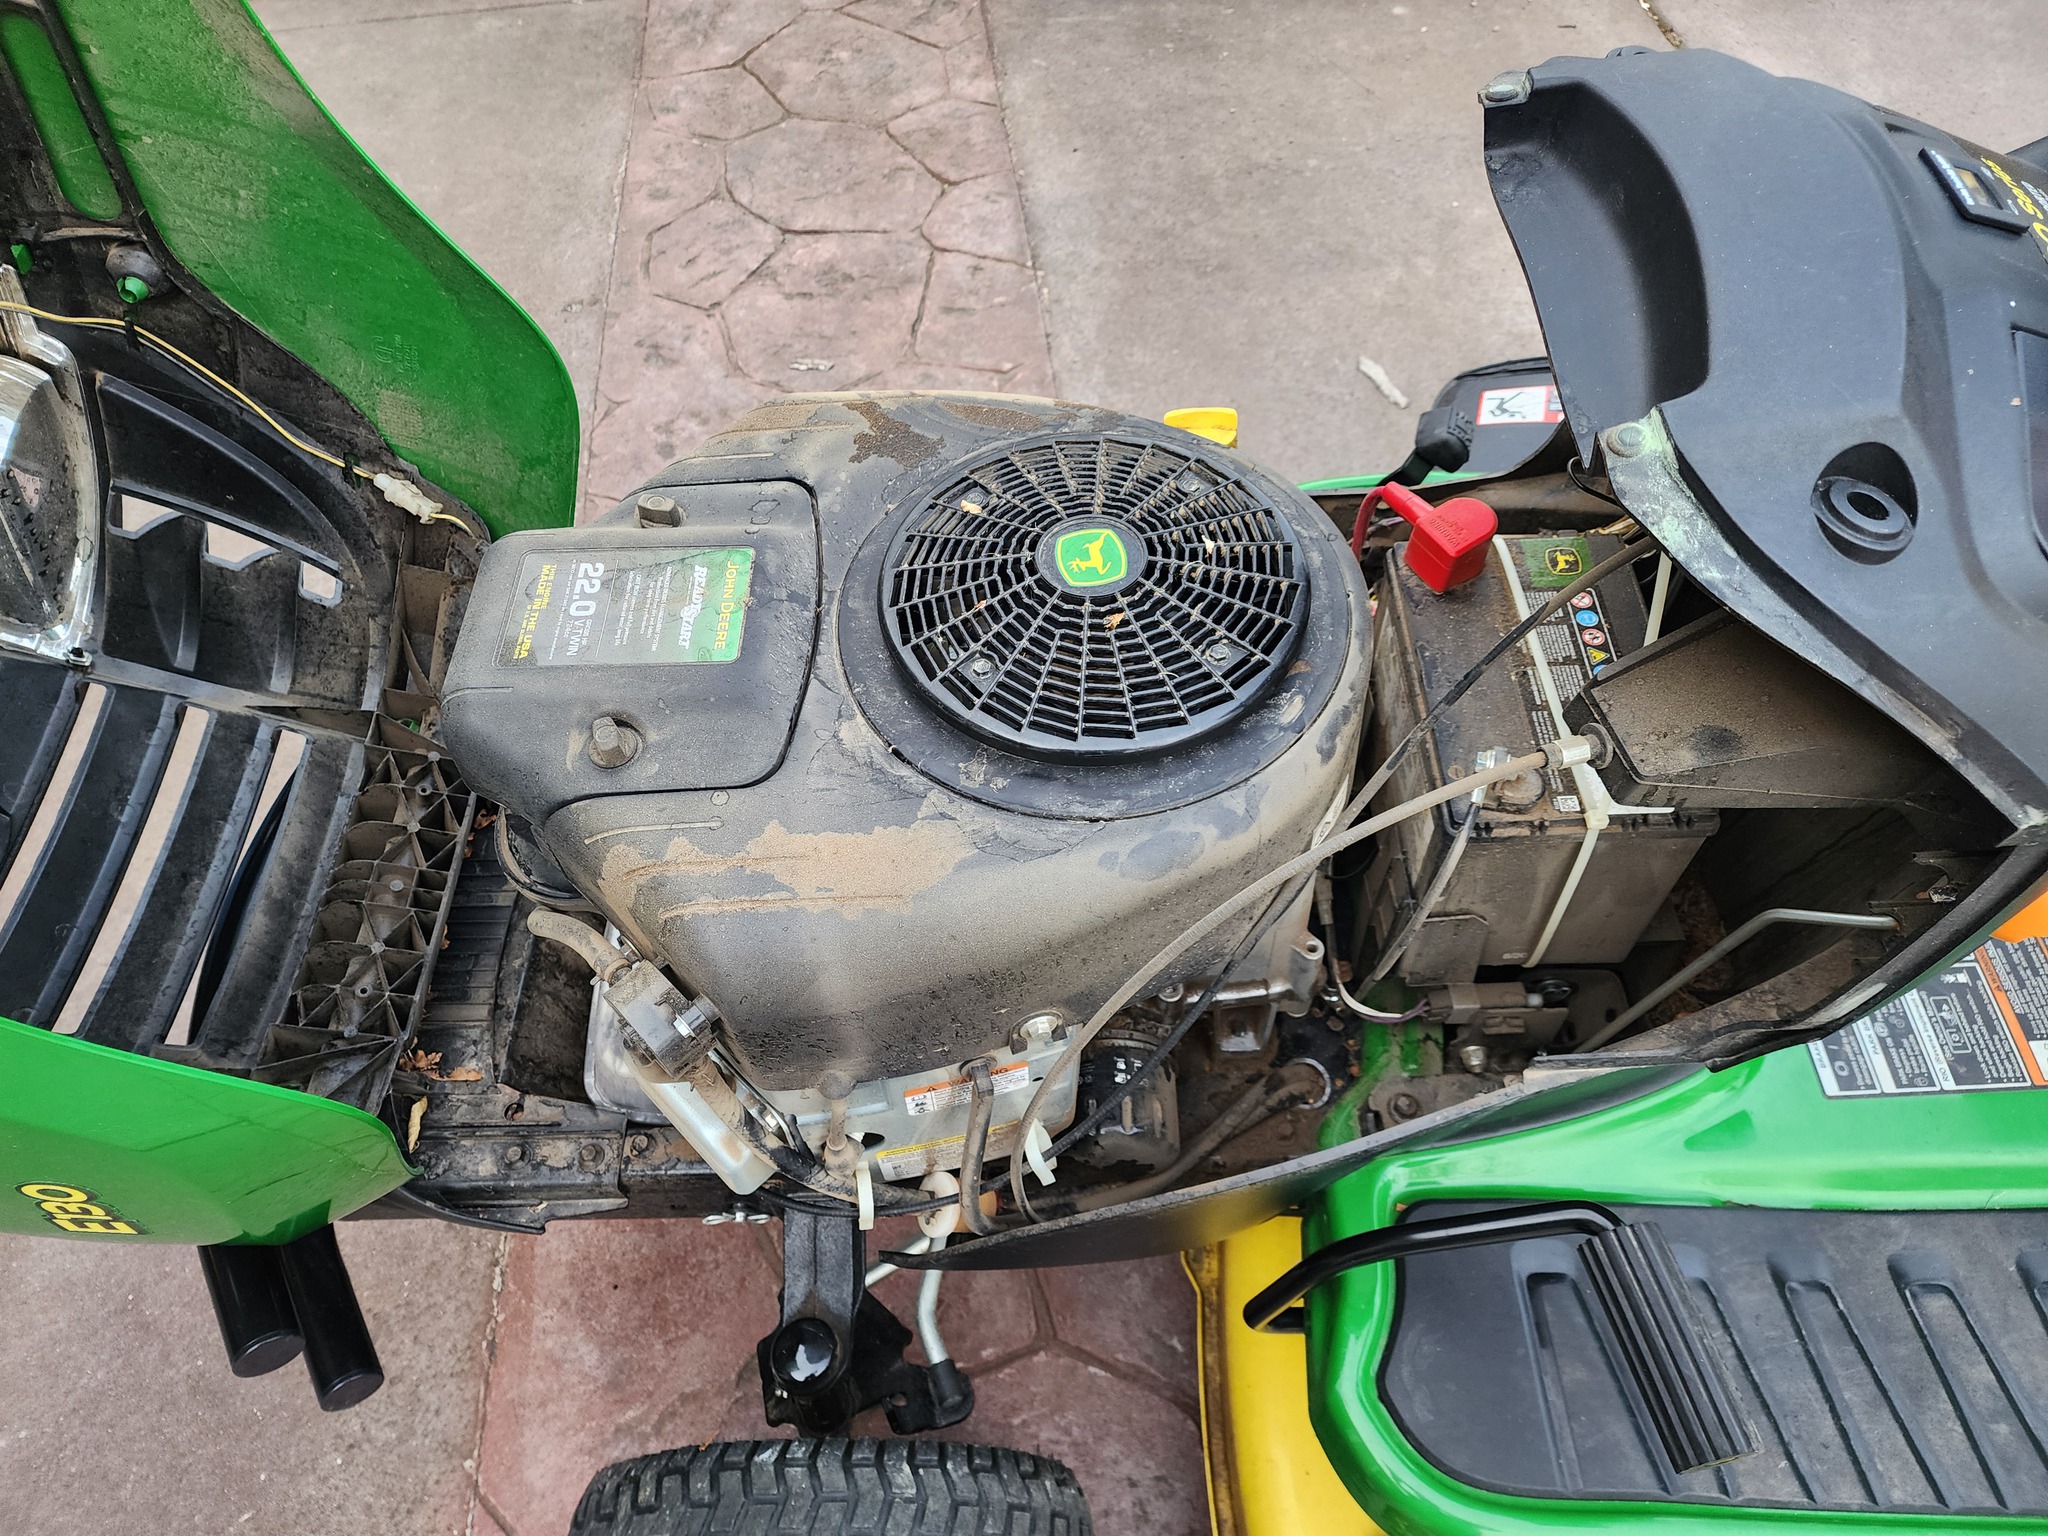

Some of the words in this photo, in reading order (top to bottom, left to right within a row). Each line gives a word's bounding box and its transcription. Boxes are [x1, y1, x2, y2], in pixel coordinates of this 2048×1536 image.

[1981, 157, 2043, 219] Series
[535, 564, 549, 595] MADE
[548, 564, 556, 579] THIS
[723, 561, 740, 599] JOHN
[540, 582, 552, 609] ENGINE
[569, 563, 605, 617] 22.0
[532, 598, 541, 609] IN
[527, 611, 537, 630] THE
[714, 602, 734, 650] DEERE
[519, 634, 531, 658] USA
[567, 620, 586, 656] V-TWIN
[1990, 958, 2010, 990] SERIOUS
[1974, 980, 1990, 1002] backing
[1949, 993, 1962, 1011] before
[1986, 1004, 1996, 1018] while
[2006, 991, 2022, 1014] AVOID
[1909, 999, 1930, 1032] Implement
[1958, 1012, 1971, 1031] behind
[1974, 1014, 1983, 1025] RIO
[1929, 1017, 1946, 1043] Owner's
[1967, 1032, 1976, 1043] and
[1971, 1024, 1986, 1047] backing
[1979, 1026, 1990, 1038] hold
[1993, 1020, 2005, 1038] switch
[1866, 1034, 1879, 1054] PARK
[1924, 1033, 1944, 1063] (Reverse
[1972, 1045, 1983, 1061] down
[1986, 1040, 1995, 1051] and
[1991, 1035, 2007, 1057] backing
[2001, 1040, 2011, 1051] RIO
[1982, 1049, 1992, 1064] while
[1991, 1053, 2007, 1077] Depress
[2007, 1053, 2022, 1076] Release
[948, 1068, 1008, 1086] WANG
[1939, 1067, 1950, 1081] RIO
[1979, 1063, 1990, 1078] Look
[1989, 1065, 1998, 1077] and
[2002, 1059, 2015, 1076] Begin
[20, 1184, 139, 1234] E130
